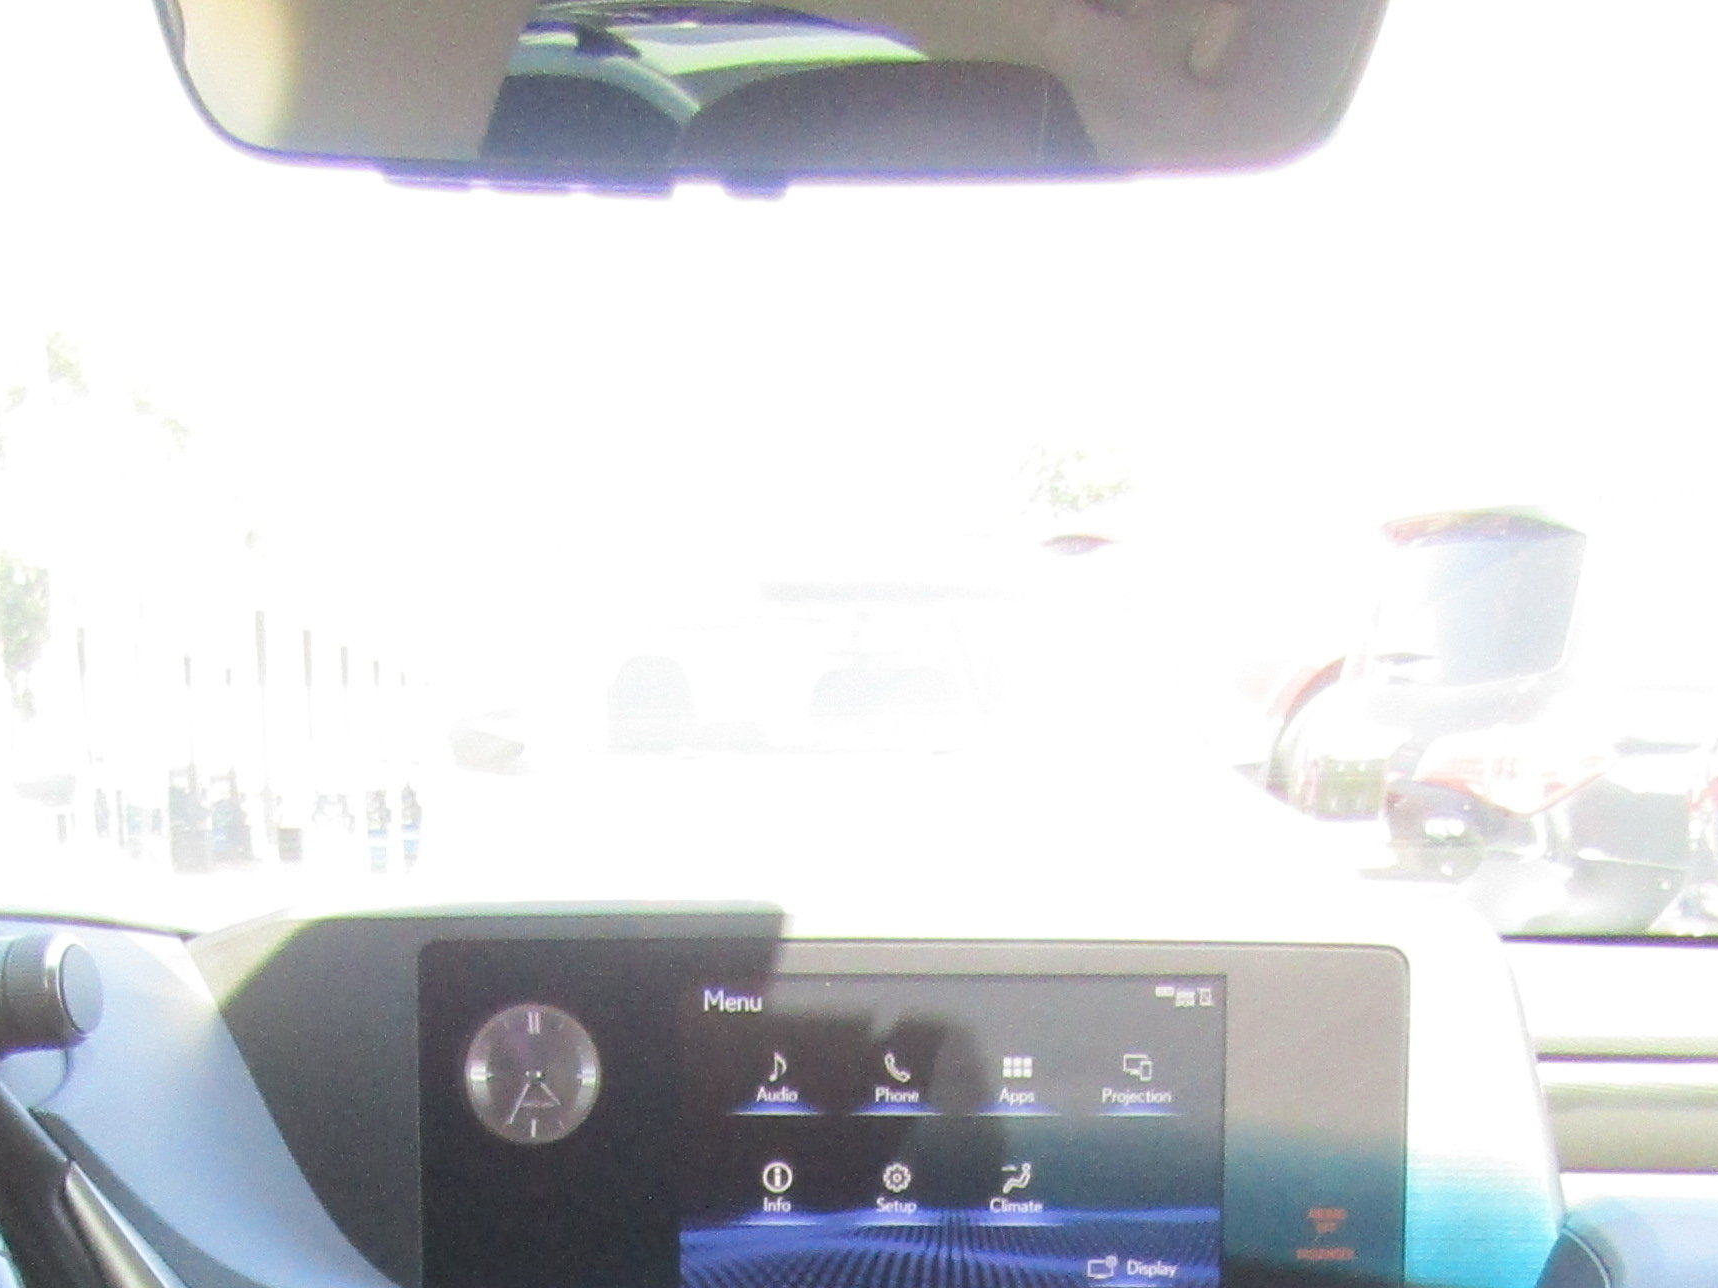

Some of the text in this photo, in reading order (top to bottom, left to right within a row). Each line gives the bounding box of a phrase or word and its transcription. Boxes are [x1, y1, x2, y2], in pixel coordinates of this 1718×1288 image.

[703, 989, 762, 1012] Menu
[756, 1086, 799, 1103] Audio
[875, 1087, 919, 1103] Phone
[999, 1087, 1035, 1106] Apps
[1102, 1087, 1172, 1106] Projection
[763, 1197, 791, 1213] Info
[876, 1198, 917, 1215] Setup
[990, 1198, 1043, 1214] Climate
[1126, 1259, 1178, 1278] Display
